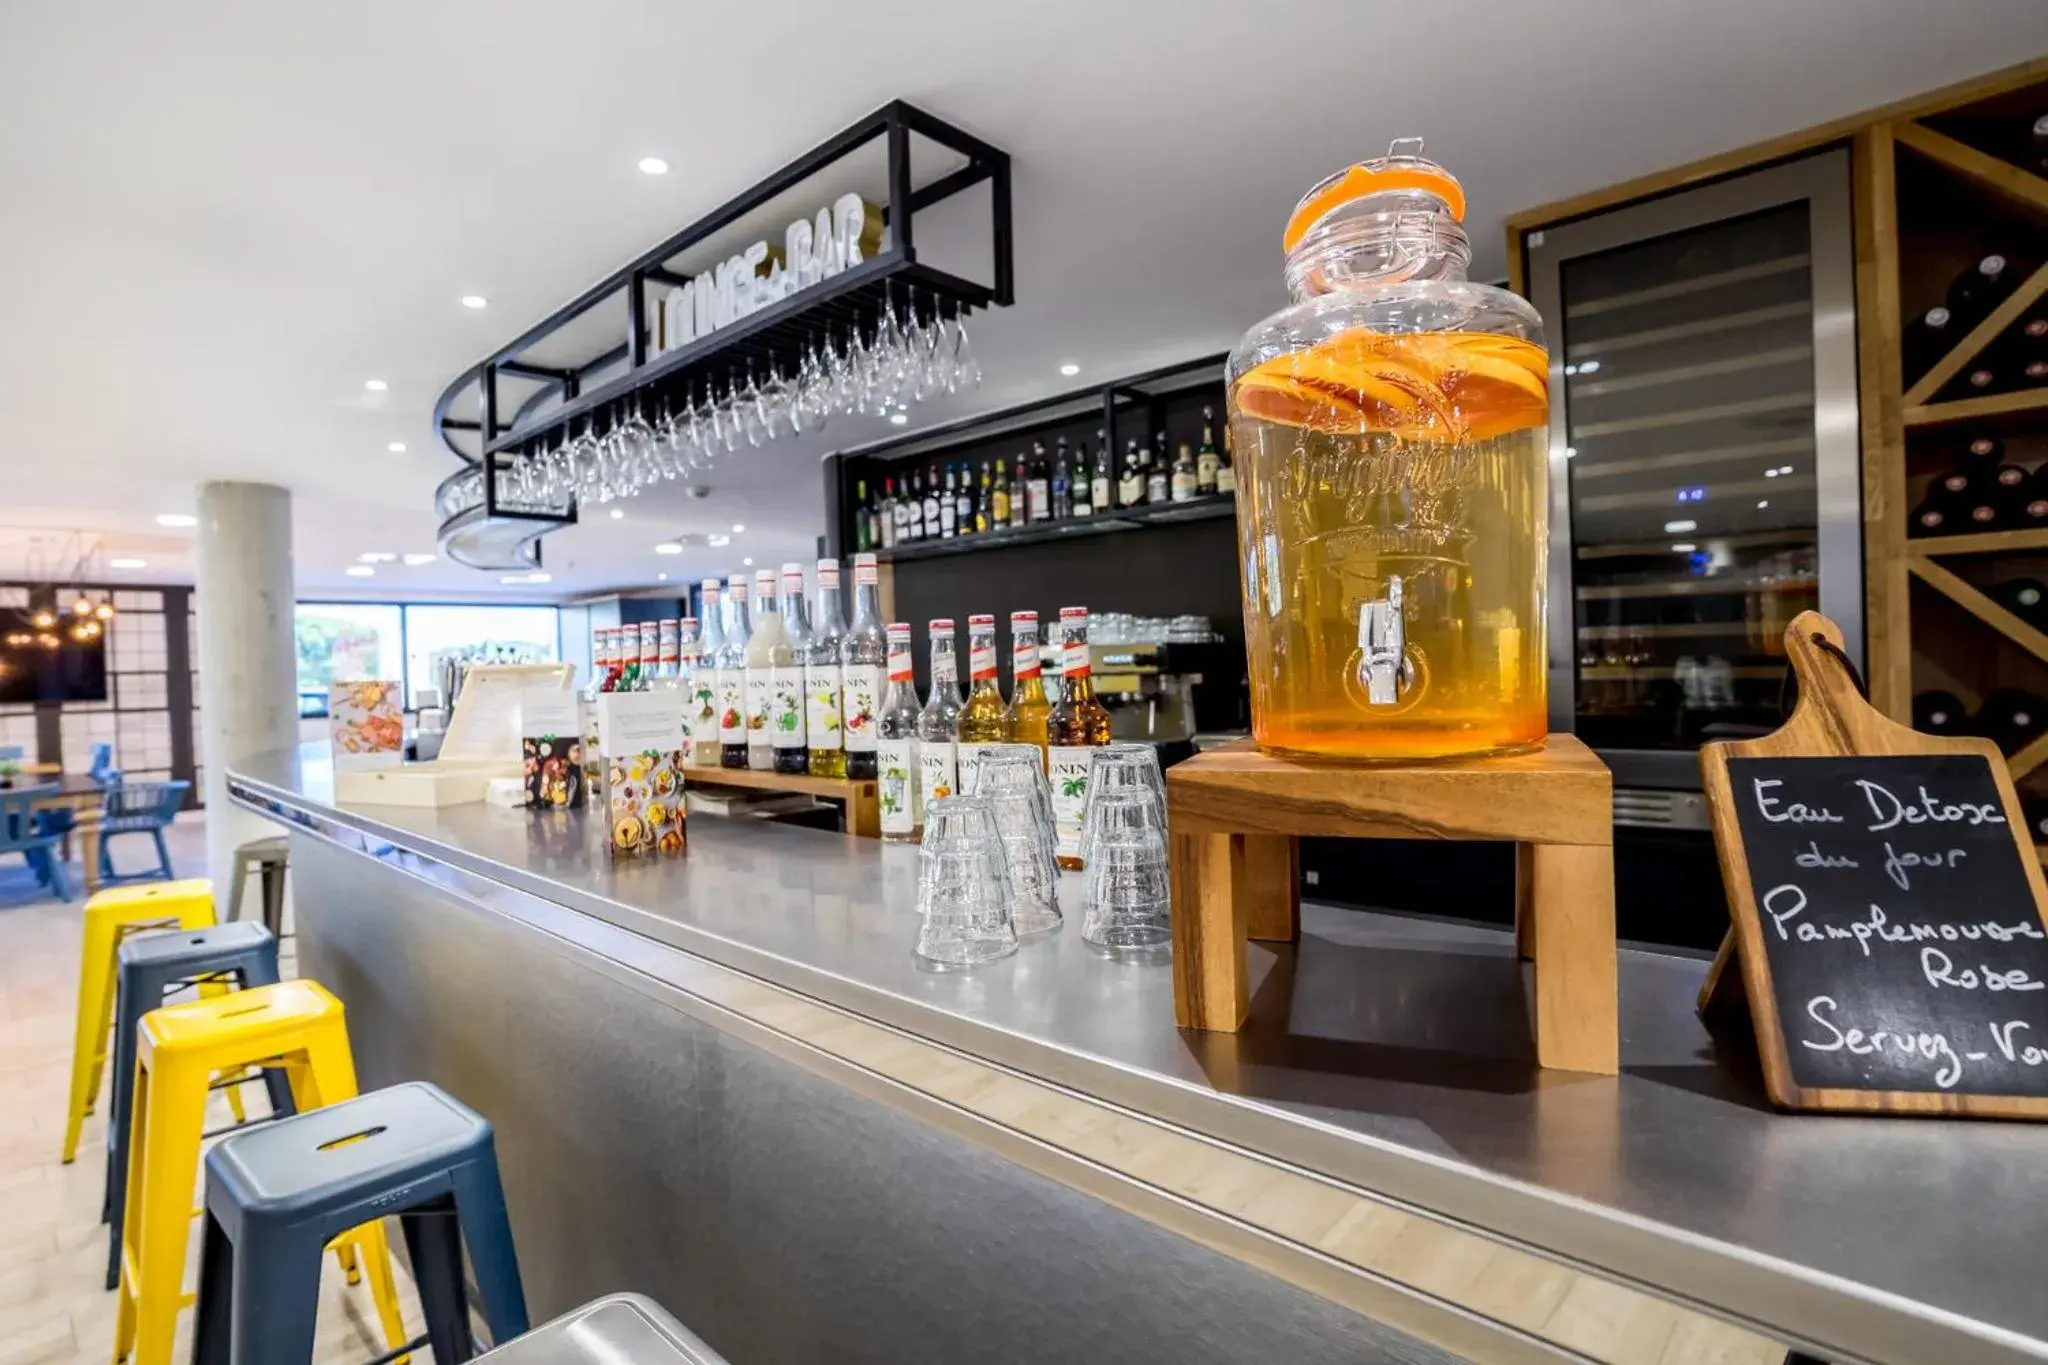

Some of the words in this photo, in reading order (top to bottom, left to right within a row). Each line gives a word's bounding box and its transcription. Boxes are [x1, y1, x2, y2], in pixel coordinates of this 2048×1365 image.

[785, 192, 866, 288] BAR
[1753, 777, 1843, 823] Eau
[1855, 778, 2006, 832] Detox
[1795, 840, 1859, 869] du
